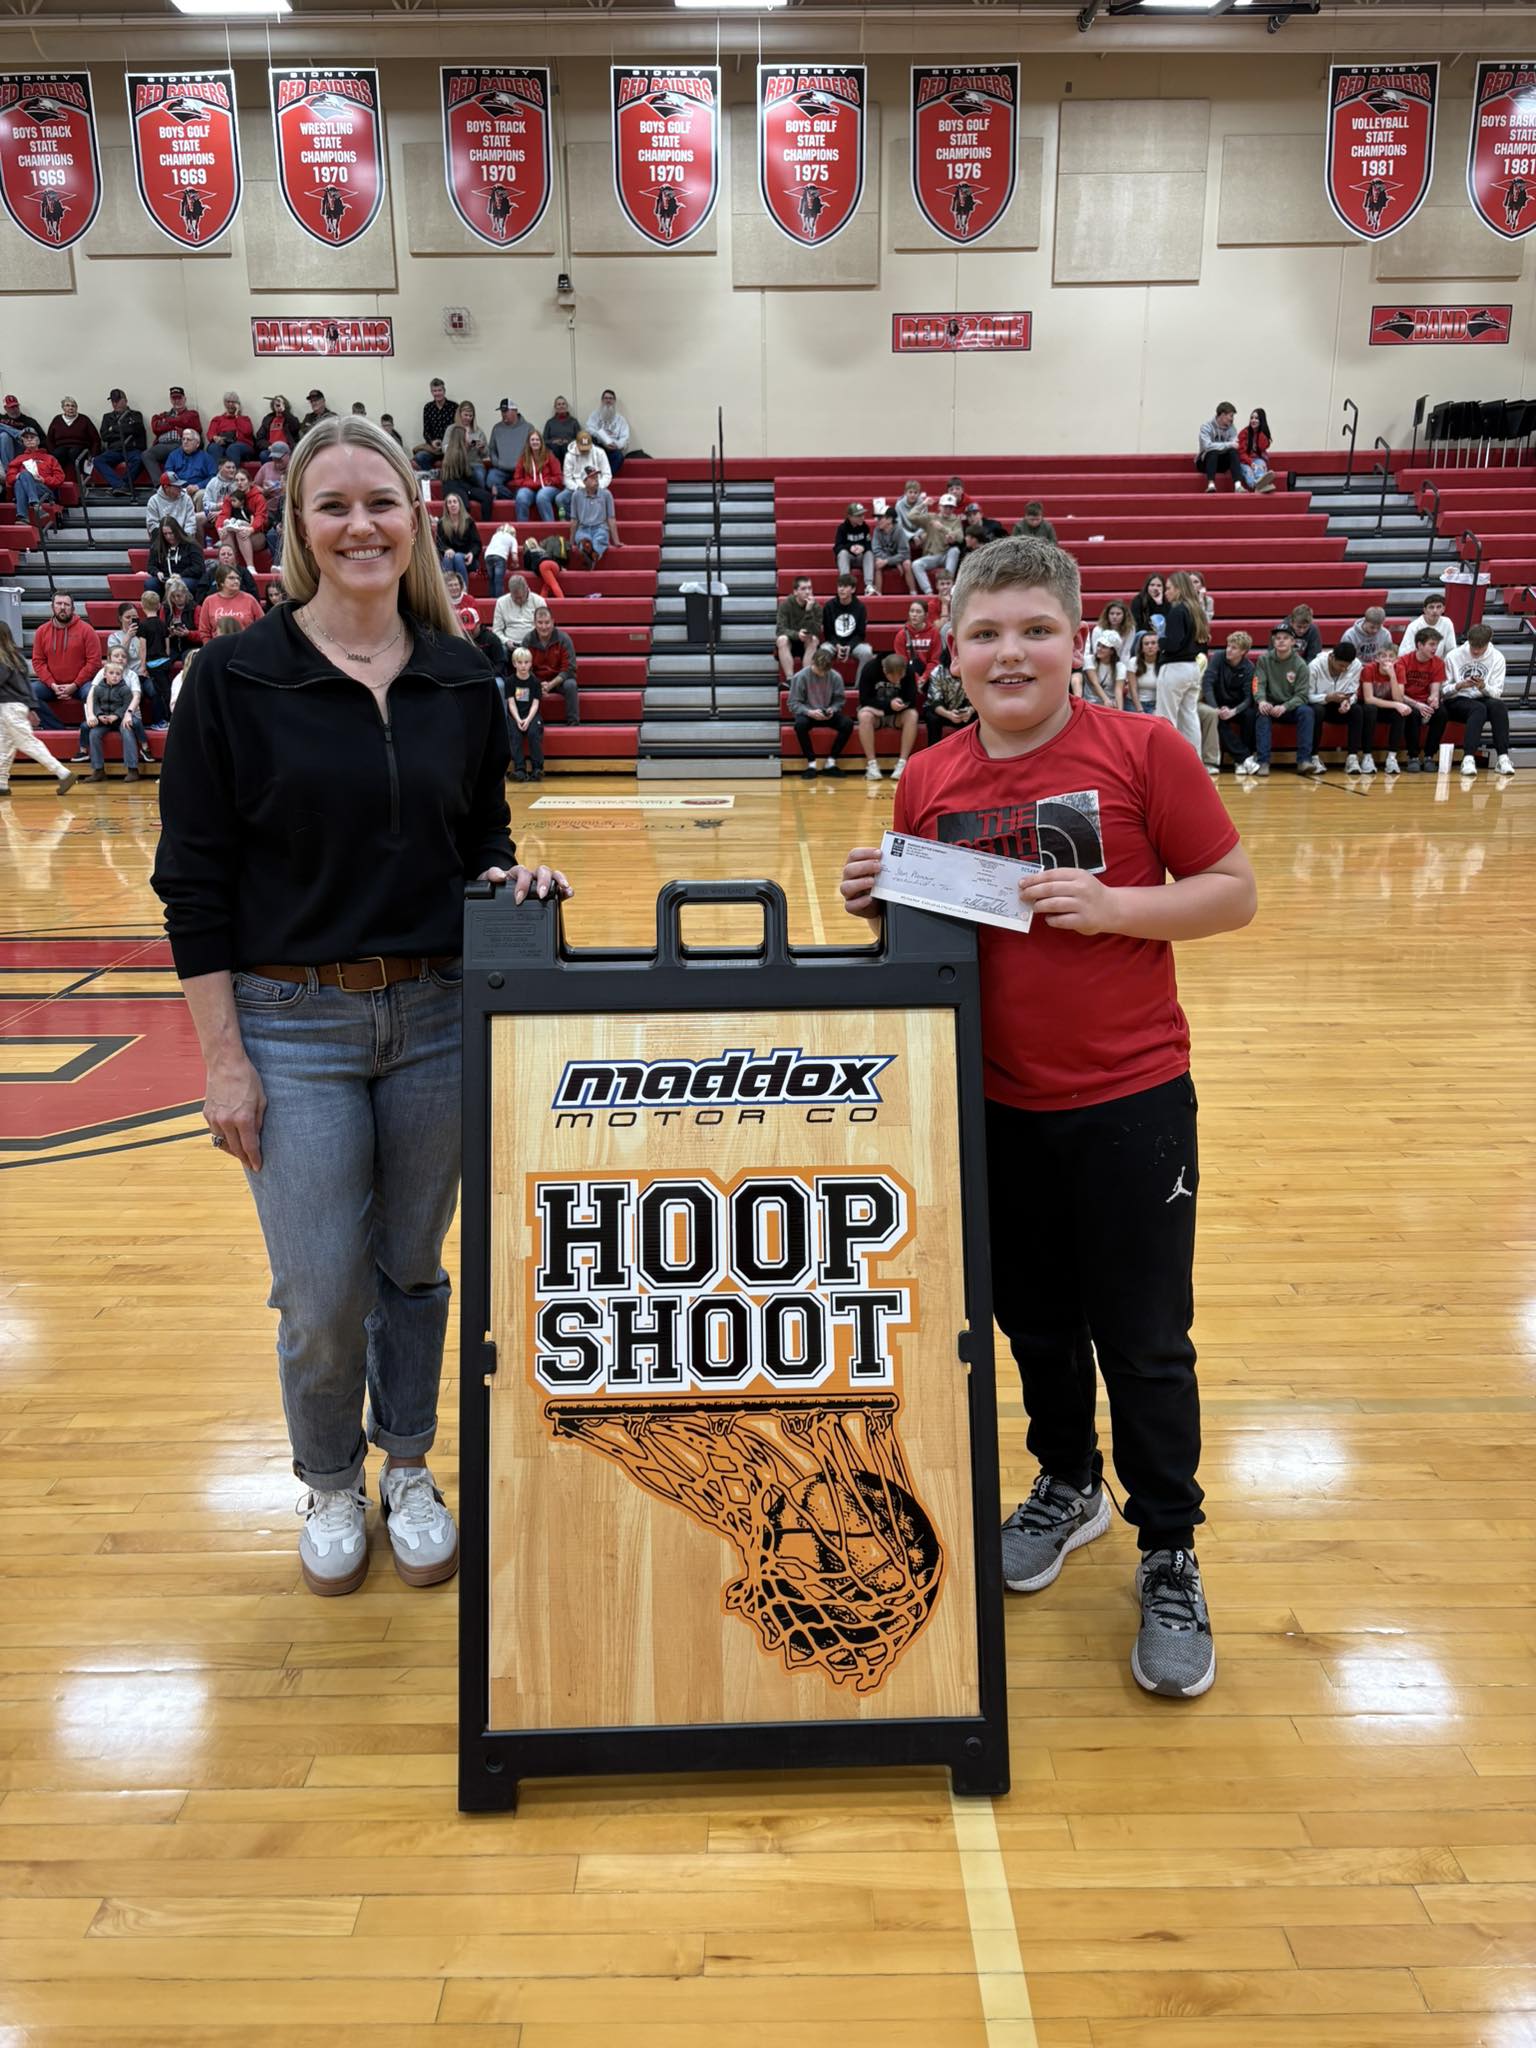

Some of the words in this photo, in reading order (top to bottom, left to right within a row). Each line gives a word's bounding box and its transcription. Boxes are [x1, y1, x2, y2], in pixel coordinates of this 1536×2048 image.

[278, 80, 305, 107] RED
[308, 79, 373, 106] RAIDERS
[448, 77, 475, 105] RED
[480, 76, 543, 105] RAIDERS
[618, 77, 647, 105] RED
[651, 77, 714, 106] RAIDERS
[765, 76, 794, 105] RED
[797, 76, 860, 105] RAIDERS
[918, 77, 947, 105] RED
[950, 75, 1013, 102] RAIDERS
[1337, 76, 1365, 102] RED
[1369, 73, 1431, 101] RAIDERS
[1482, 72, 1514, 101] RED
[22, 83, 87, 109] RAIDERS
[136, 84, 164, 111] RED
[167, 82, 229, 110] RAIDERS
[466, 121, 492, 133] BOYS
[495, 121, 526, 133] TRACK
[640, 121, 665, 134] BOYS
[669, 121, 691, 134] GOLF
[785, 120, 811, 132] BOYS
[814, 120, 837, 132] GOLF
[938, 120, 964, 131] BOYS
[967, 119, 990, 131] GOLF
[1352, 117, 1409, 129] VOLLEYBALL
[1482, 116, 1507, 127] BOYS
[1510, 115, 1536, 127] BASK
[12, 127, 38, 139] BOYS
[41, 126, 72, 138] TRACK
[159, 127, 185, 138] BOYS
[188, 126, 210, 138] GOLF
[300, 122, 353, 135] WRESTLING
[313, 137, 342, 149] STATE
[482, 136, 511, 147] STATE
[651, 136, 680, 148] STATE
[797, 135, 825, 147] STATE
[950, 134, 978, 145] STATE
[1366, 131, 1394, 142] STATE
[30, 140, 58, 152] STATE
[172, 140, 200, 152] STATE
[936, 147, 991, 159] CHAMPIONS
[1351, 145, 1407, 157] CHAMPIONS
[1494, 143, 1536, 155] CHAMPIO
[18, 153, 74, 166] CHAMPIONS
[159, 153, 215, 166] CHAMPIONS
[301, 150, 357, 163] CHAMPIONS
[469, 150, 525, 161] CHAMPIONS
[638, 150, 694, 162] CHAMPIONS
[783, 149, 839, 161] CHAMPIONS
[794, 165, 829, 181] 1975
[947, 163, 981, 179] 1976
[1361, 160, 1394, 176] 1981
[1504, 159, 1536, 174] 1981
[31, 170, 66, 185] 1969
[172, 169, 207, 184] 1969
[313, 167, 348, 182] 1970
[481, 166, 516, 182] 1970
[649, 166, 685, 182] 1970
[1414, 309, 1469, 340] BAND
[900, 318, 947, 348] RED
[976, 806, 1035, 836] THE
[953, 828, 1038, 855] RTH
[553, 1048, 894, 1108] maddox
[555, 1110, 765, 1129] MOTOR
[807, 1107, 878, 1123] CO
[535, 1176, 907, 1293] HOOP
[535, 1291, 905, 1386] SHOOT
